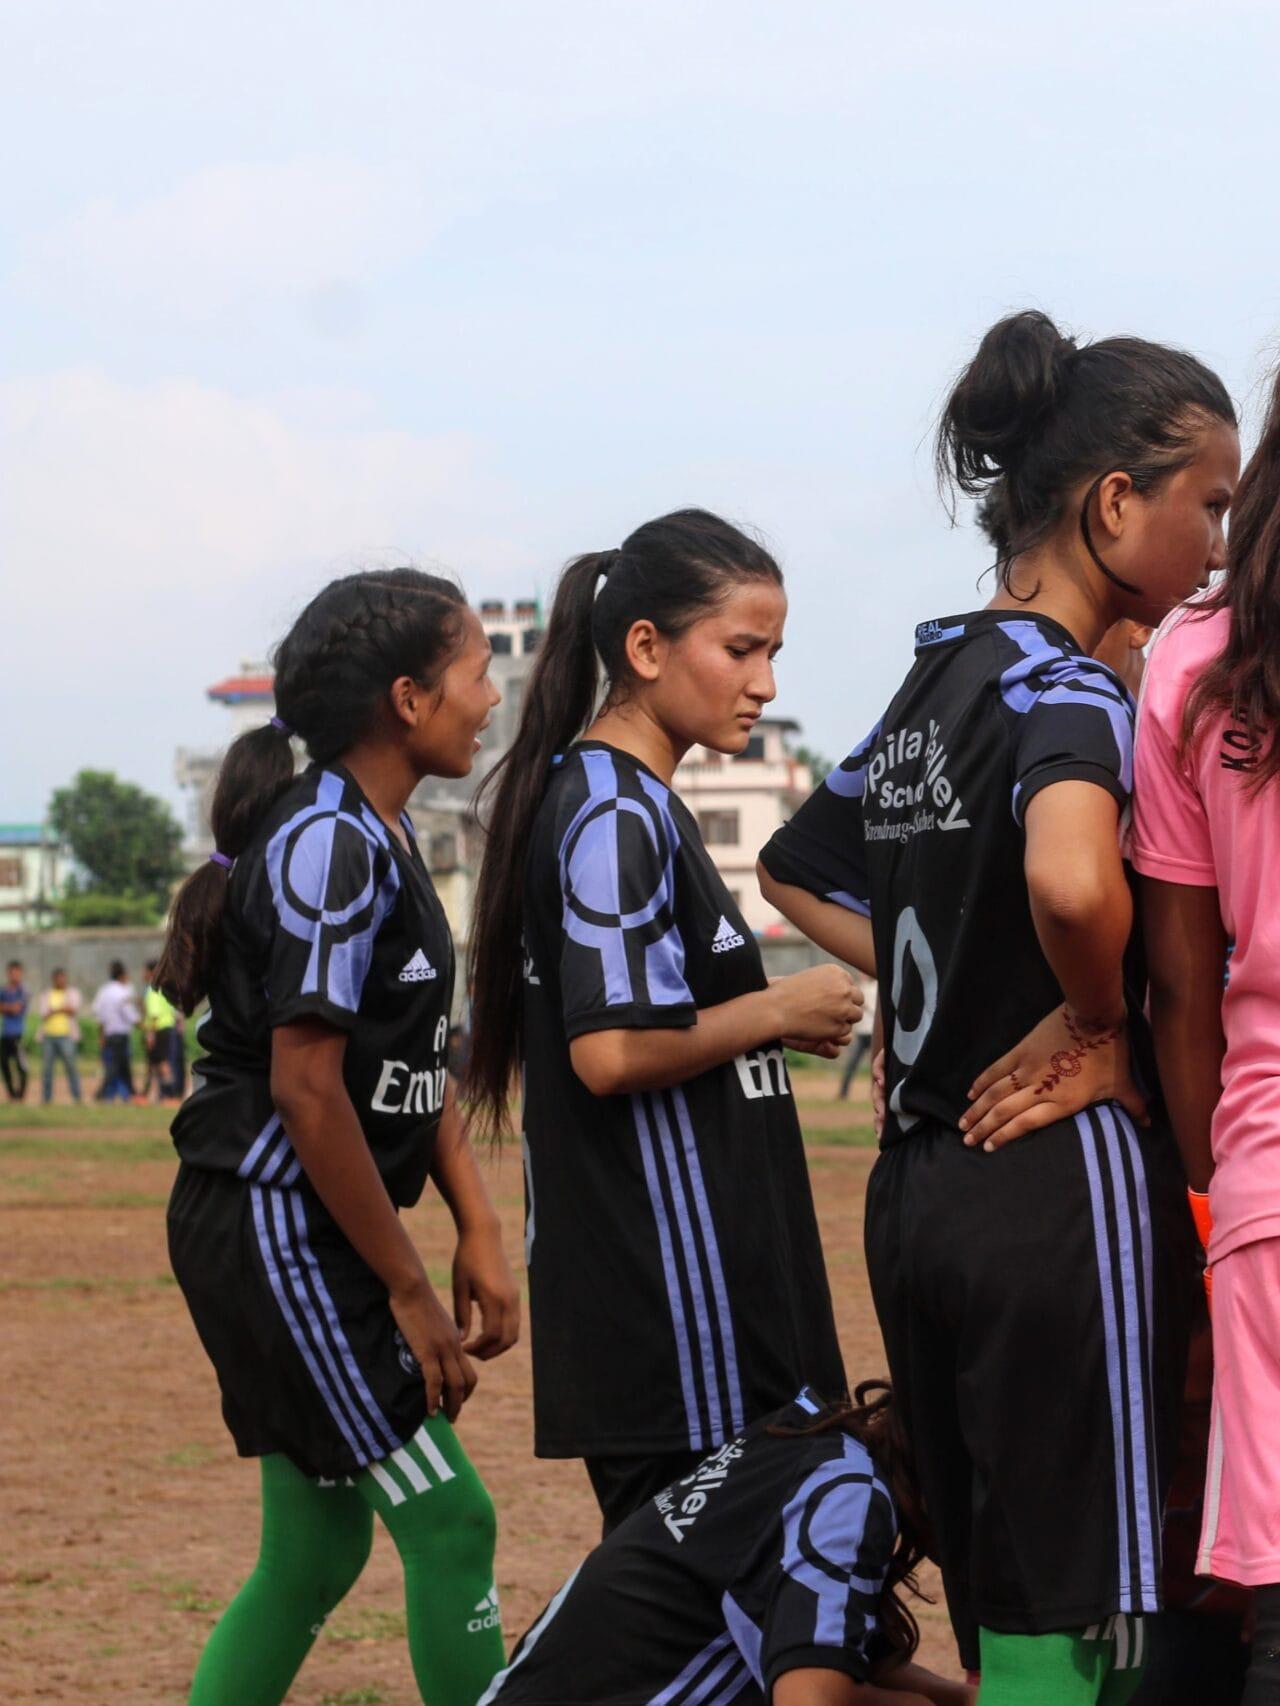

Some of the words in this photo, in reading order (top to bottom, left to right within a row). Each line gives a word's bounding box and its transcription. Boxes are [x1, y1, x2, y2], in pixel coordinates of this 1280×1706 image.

[862, 728, 923, 806] pila
[711, 933, 746, 954] adidas
[399, 968, 437, 982] adidas
